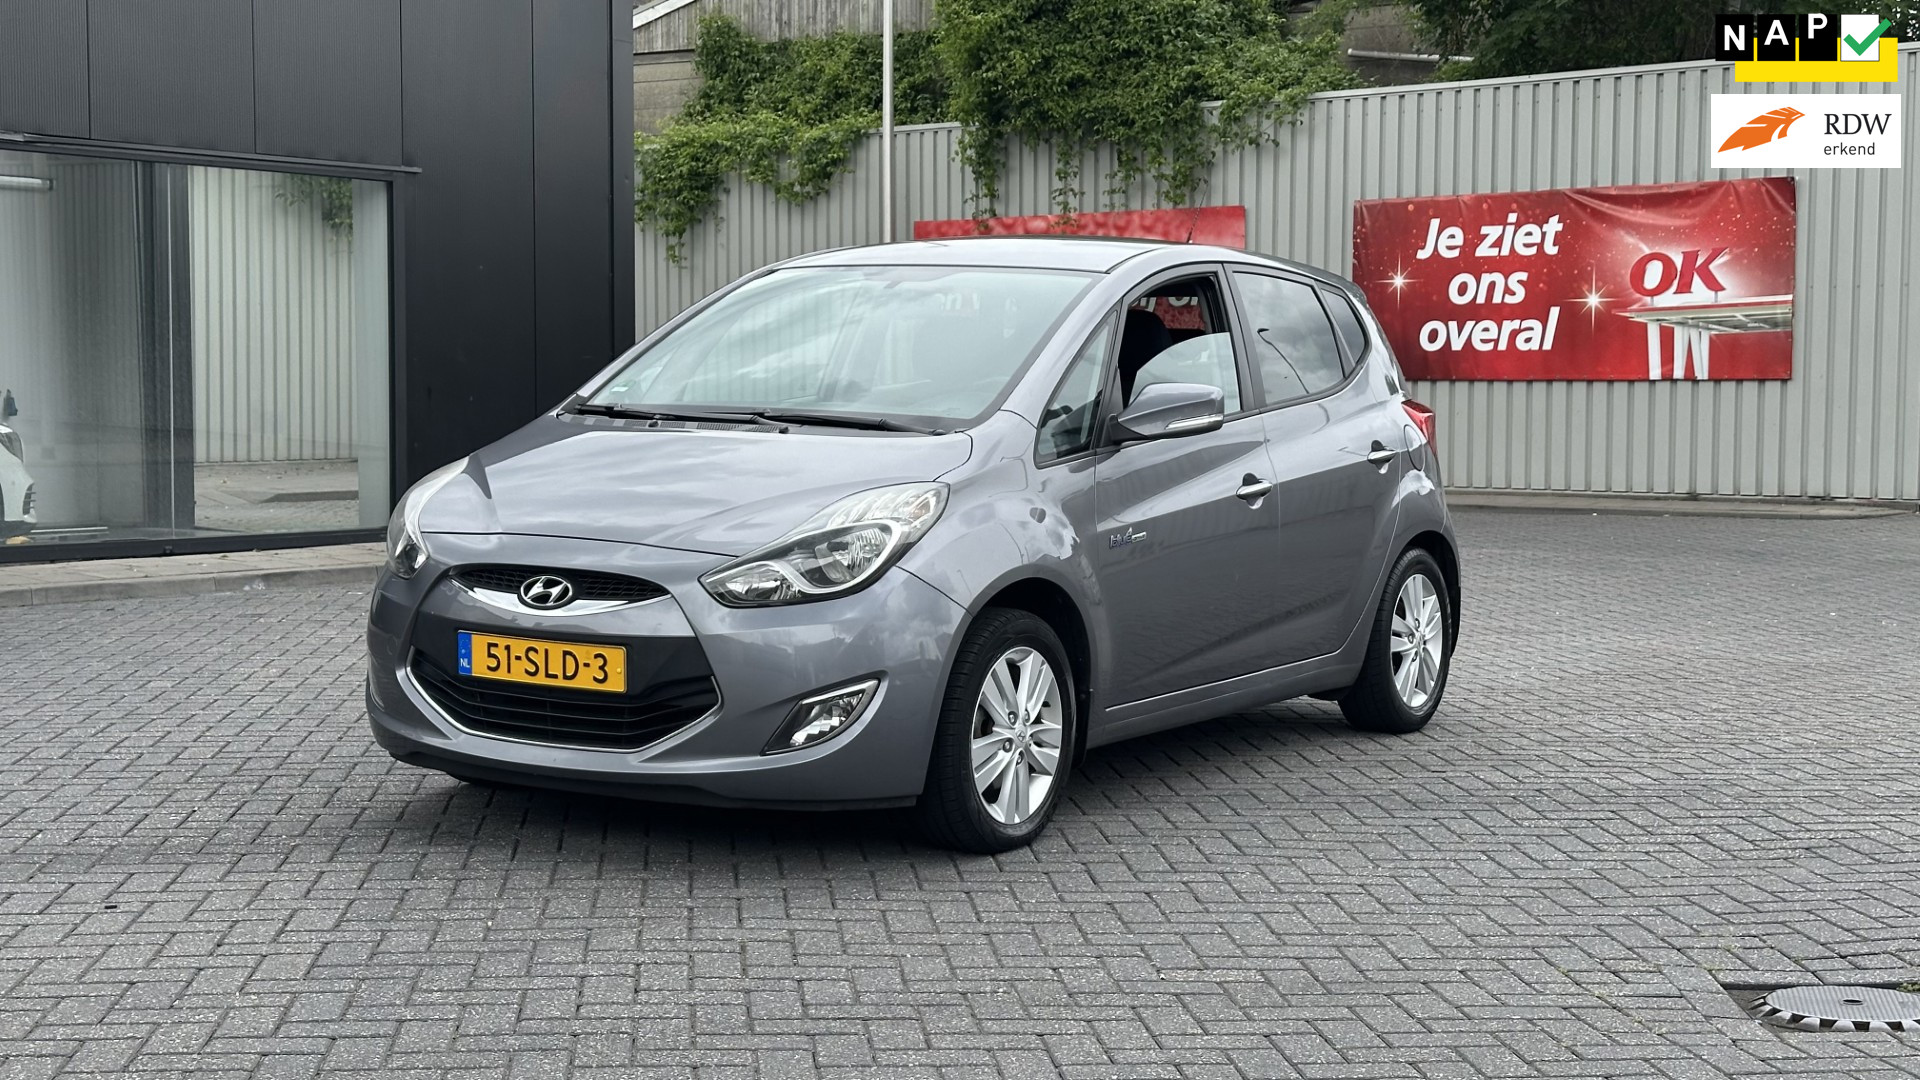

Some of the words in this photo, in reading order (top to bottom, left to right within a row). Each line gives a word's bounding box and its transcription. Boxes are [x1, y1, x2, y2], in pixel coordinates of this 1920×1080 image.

[1416, 217, 1465, 259] Je
[1474, 212, 1563, 257] ziet
[1448, 269, 1528, 305] ons
[1629, 247, 1729, 298] OK
[1419, 306, 1561, 352] overal
[460, 658, 470, 668] NL
[486, 641, 609, 684] 51-SLD-3
